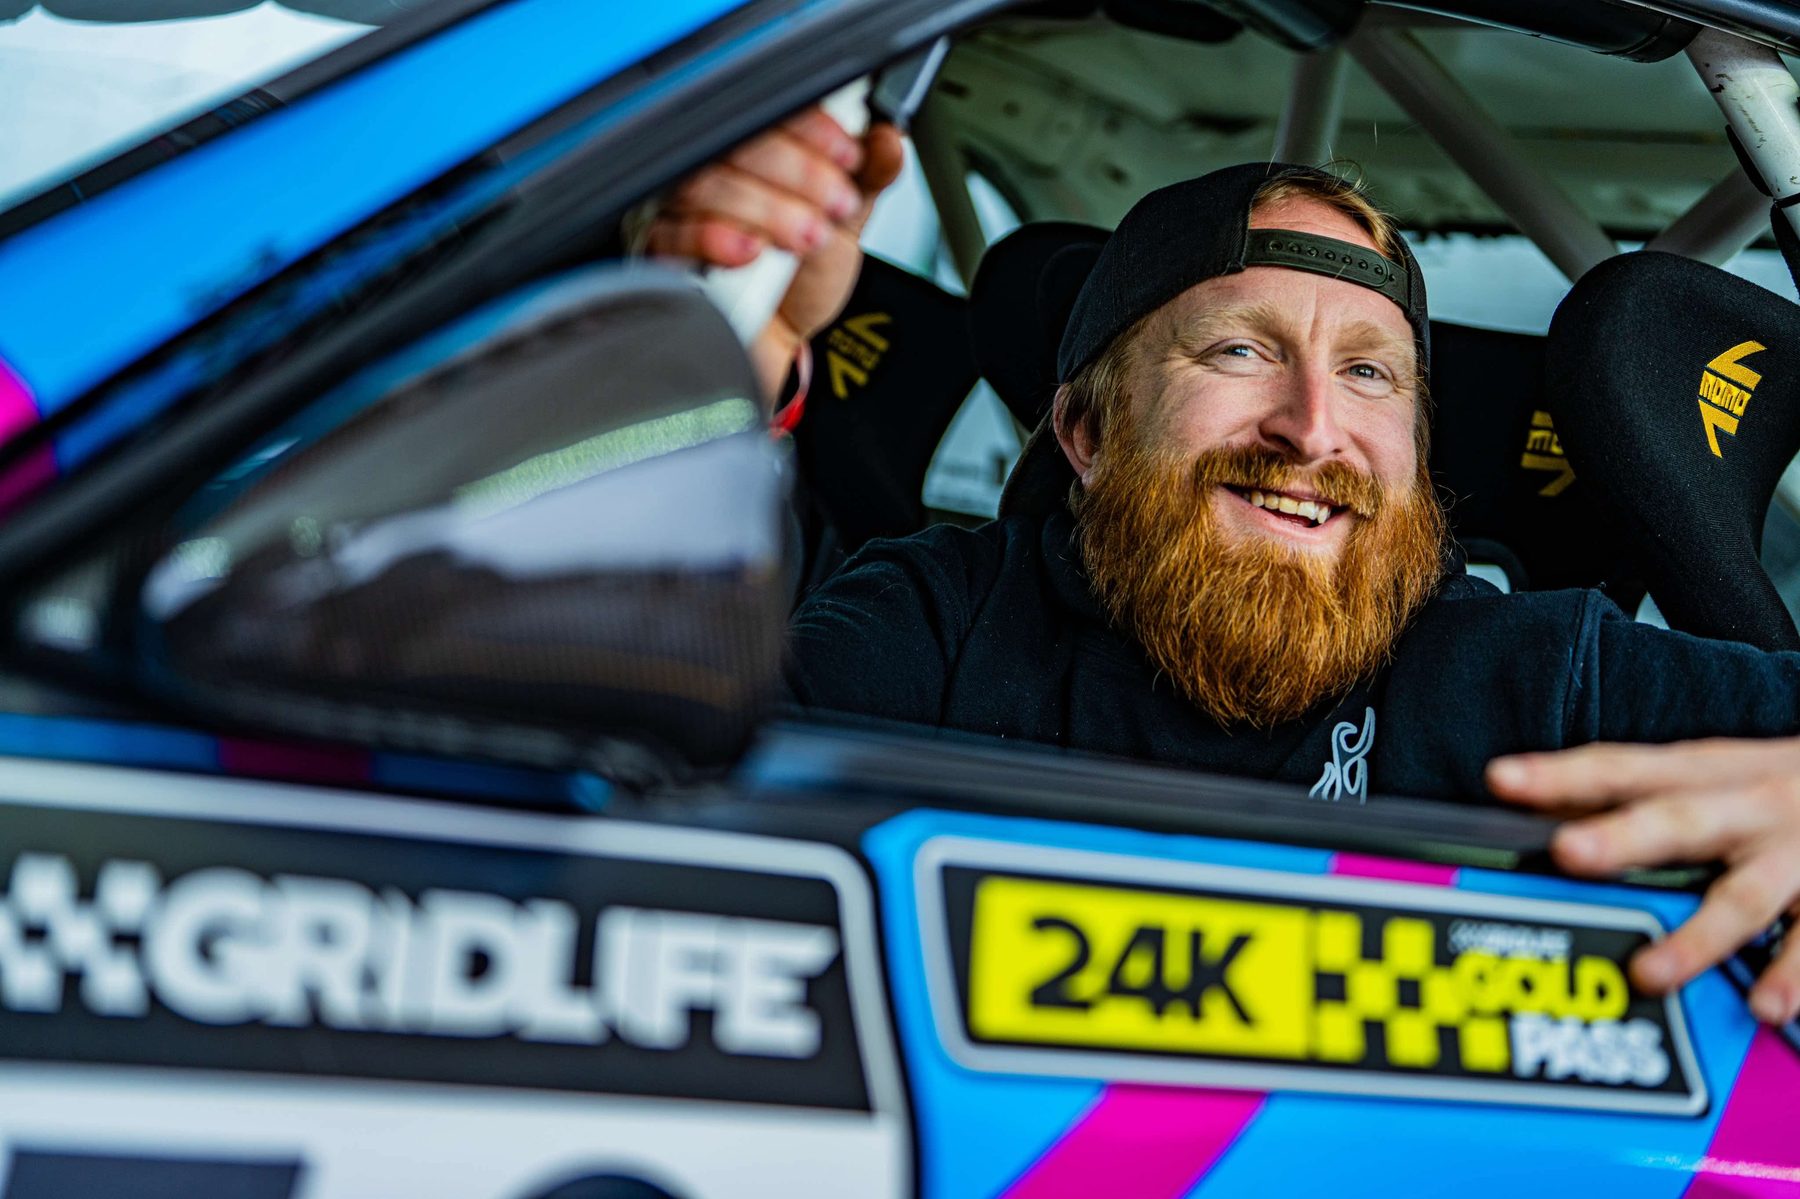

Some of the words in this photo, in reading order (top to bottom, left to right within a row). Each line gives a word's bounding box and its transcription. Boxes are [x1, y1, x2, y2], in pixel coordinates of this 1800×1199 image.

[146, 868, 840, 1056] GRIDLIFE
[1031, 916, 1254, 1027] 24K
[1454, 949, 1629, 1021] GOLD
[1510, 1012, 1669, 1087] PASS
